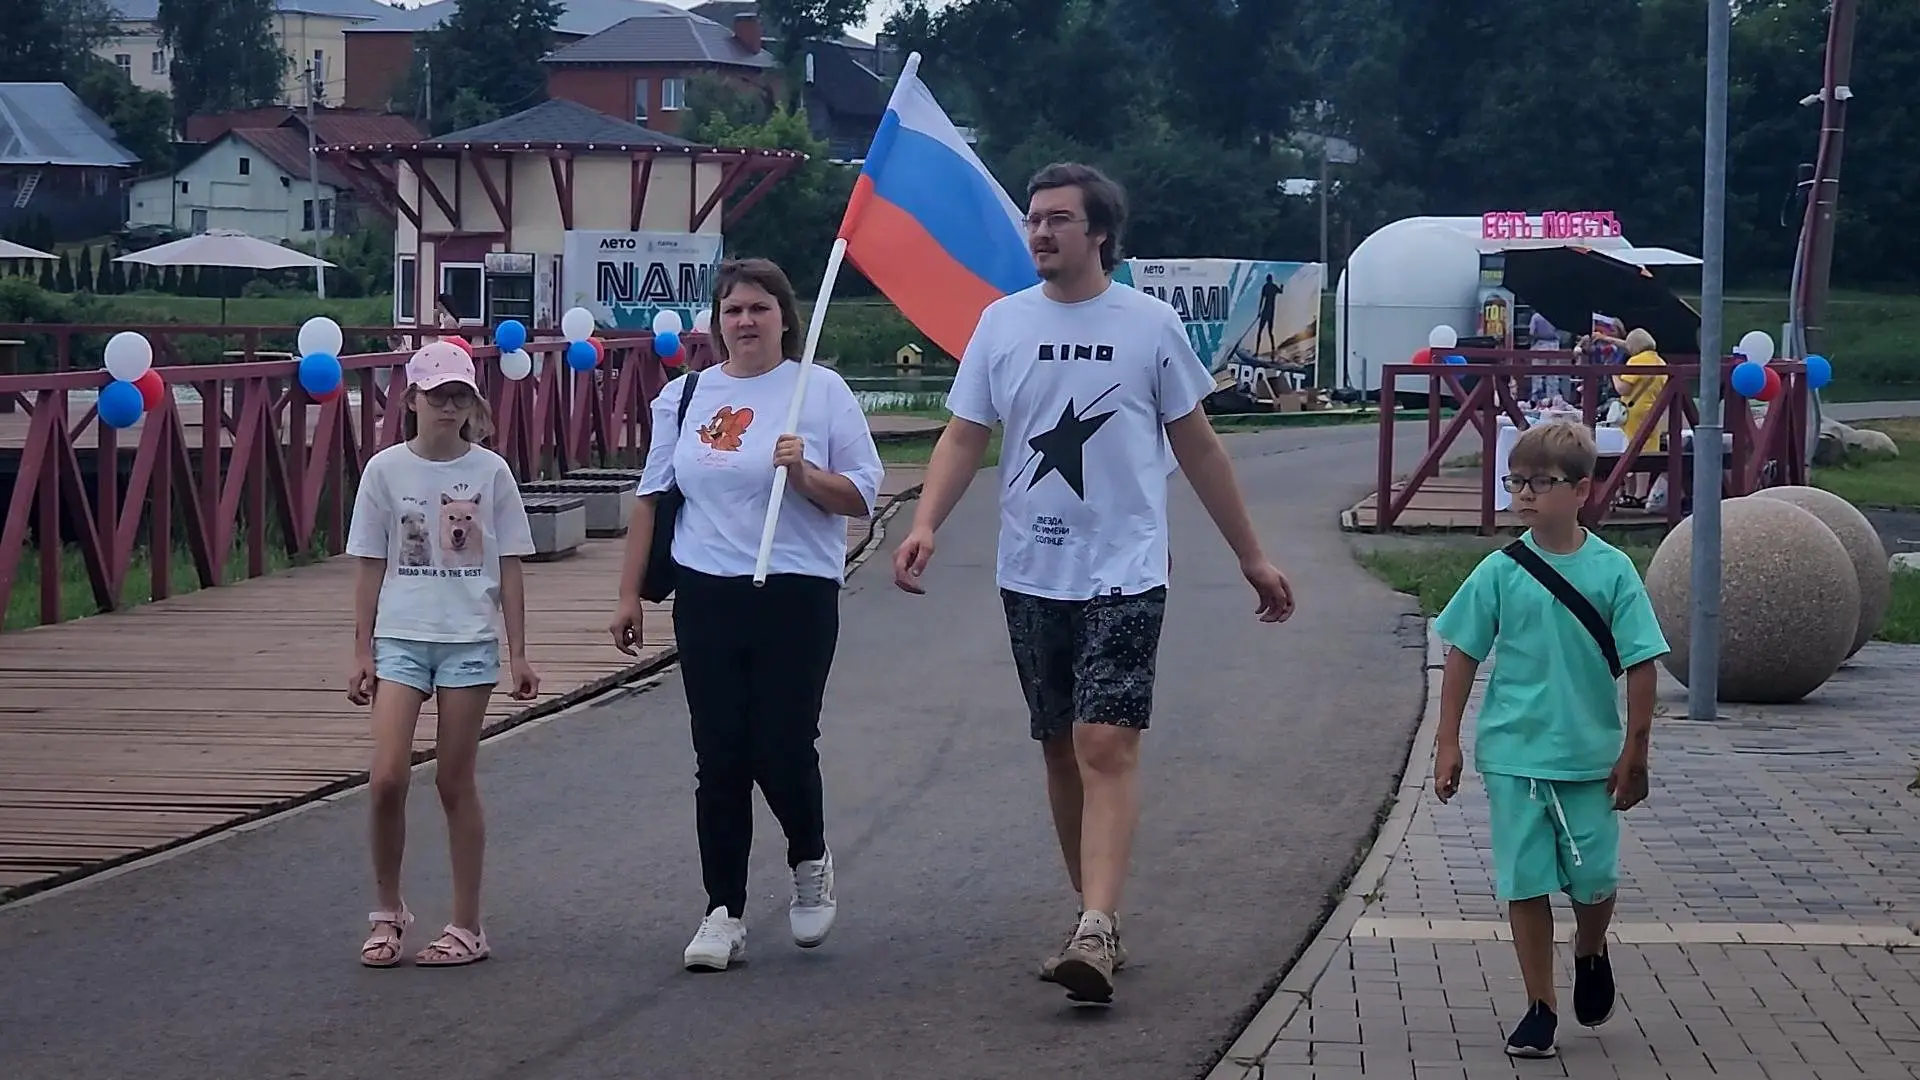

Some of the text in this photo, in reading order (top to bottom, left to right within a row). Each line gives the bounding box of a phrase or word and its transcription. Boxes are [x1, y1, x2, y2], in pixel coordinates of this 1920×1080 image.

[1483, 210, 1622, 239] ЕСТЬ ПОЕСТЬ
[1035, 535, 1064, 546] СОЛНЦЕ
